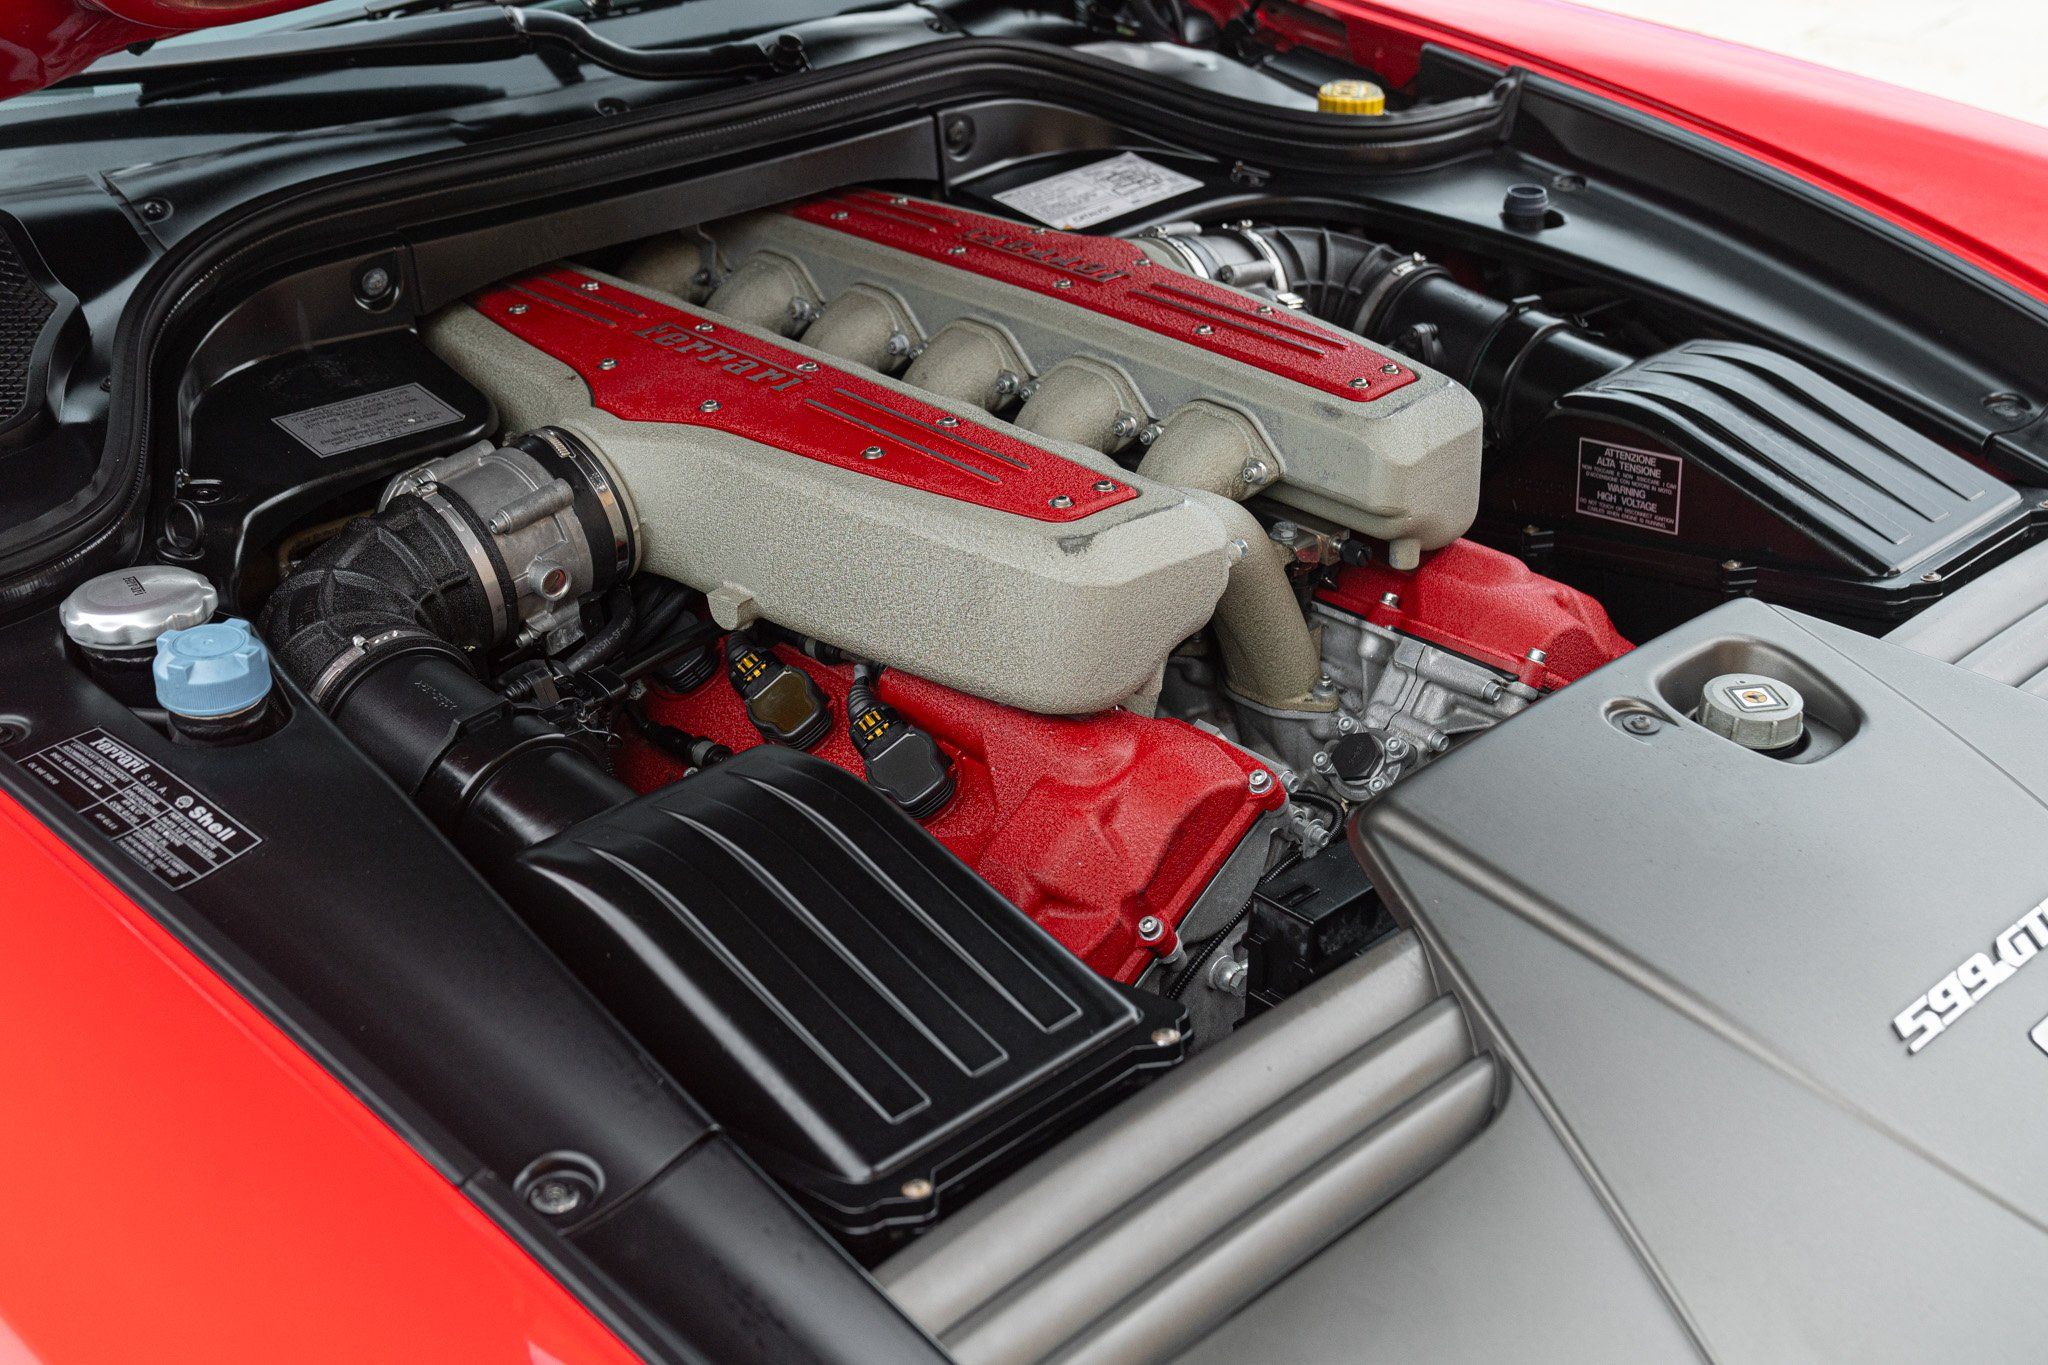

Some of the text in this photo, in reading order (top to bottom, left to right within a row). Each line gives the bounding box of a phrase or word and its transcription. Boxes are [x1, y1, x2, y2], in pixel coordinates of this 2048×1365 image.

[634, 321, 812, 391] Ferrari
[1597, 457, 1661, 479] ALTA TENSIONE
[1605, 448, 1656, 467] ATTENZIONE
[1597, 490, 1617, 503] HIGH
[1607, 482, 1646, 500] WARNING
[89, 737, 150, 774] Ferrari
[188, 805, 237, 842] Shell
[1892, 897, 2048, 1053] 599 GT
